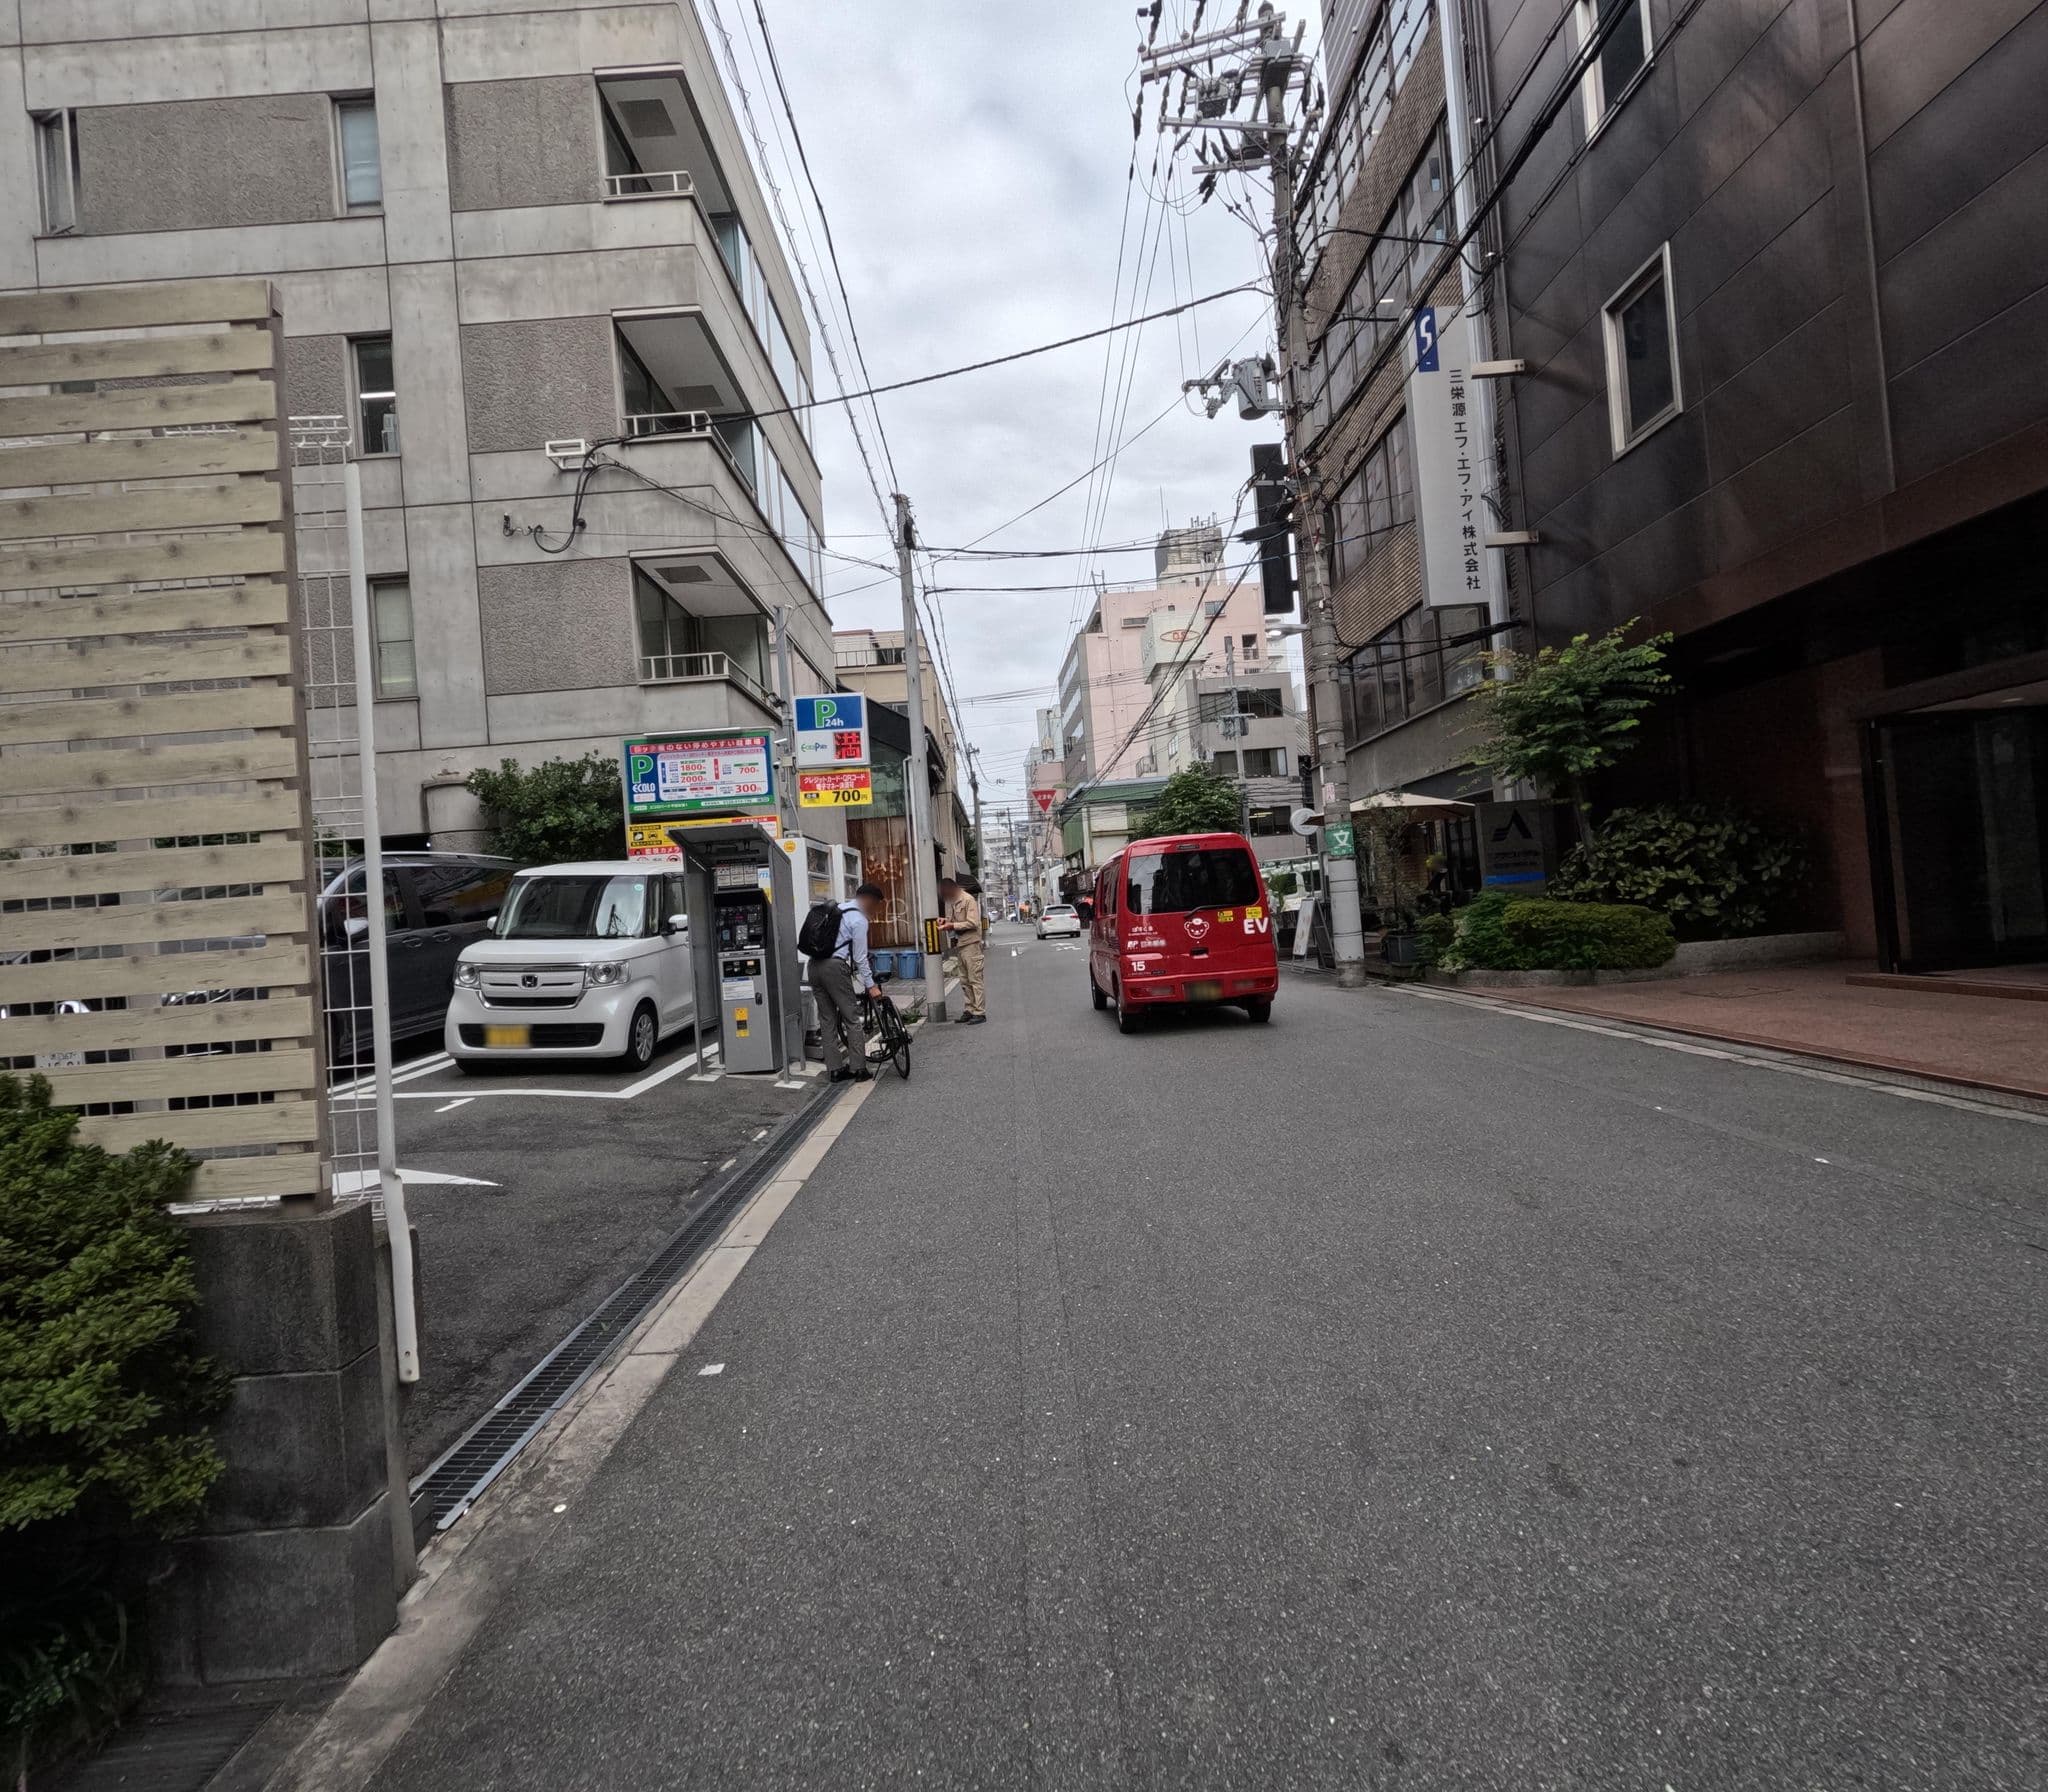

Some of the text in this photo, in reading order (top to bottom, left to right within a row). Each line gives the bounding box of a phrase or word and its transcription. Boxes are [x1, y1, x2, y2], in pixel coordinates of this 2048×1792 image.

[814, 699, 837, 729] P
[825, 718, 844, 727] 24h
[630, 755, 654, 784] P
[1333, 830, 1350, 846] 文
[1243, 917, 1269, 935] EV
[1131, 961, 1146, 972] 15
